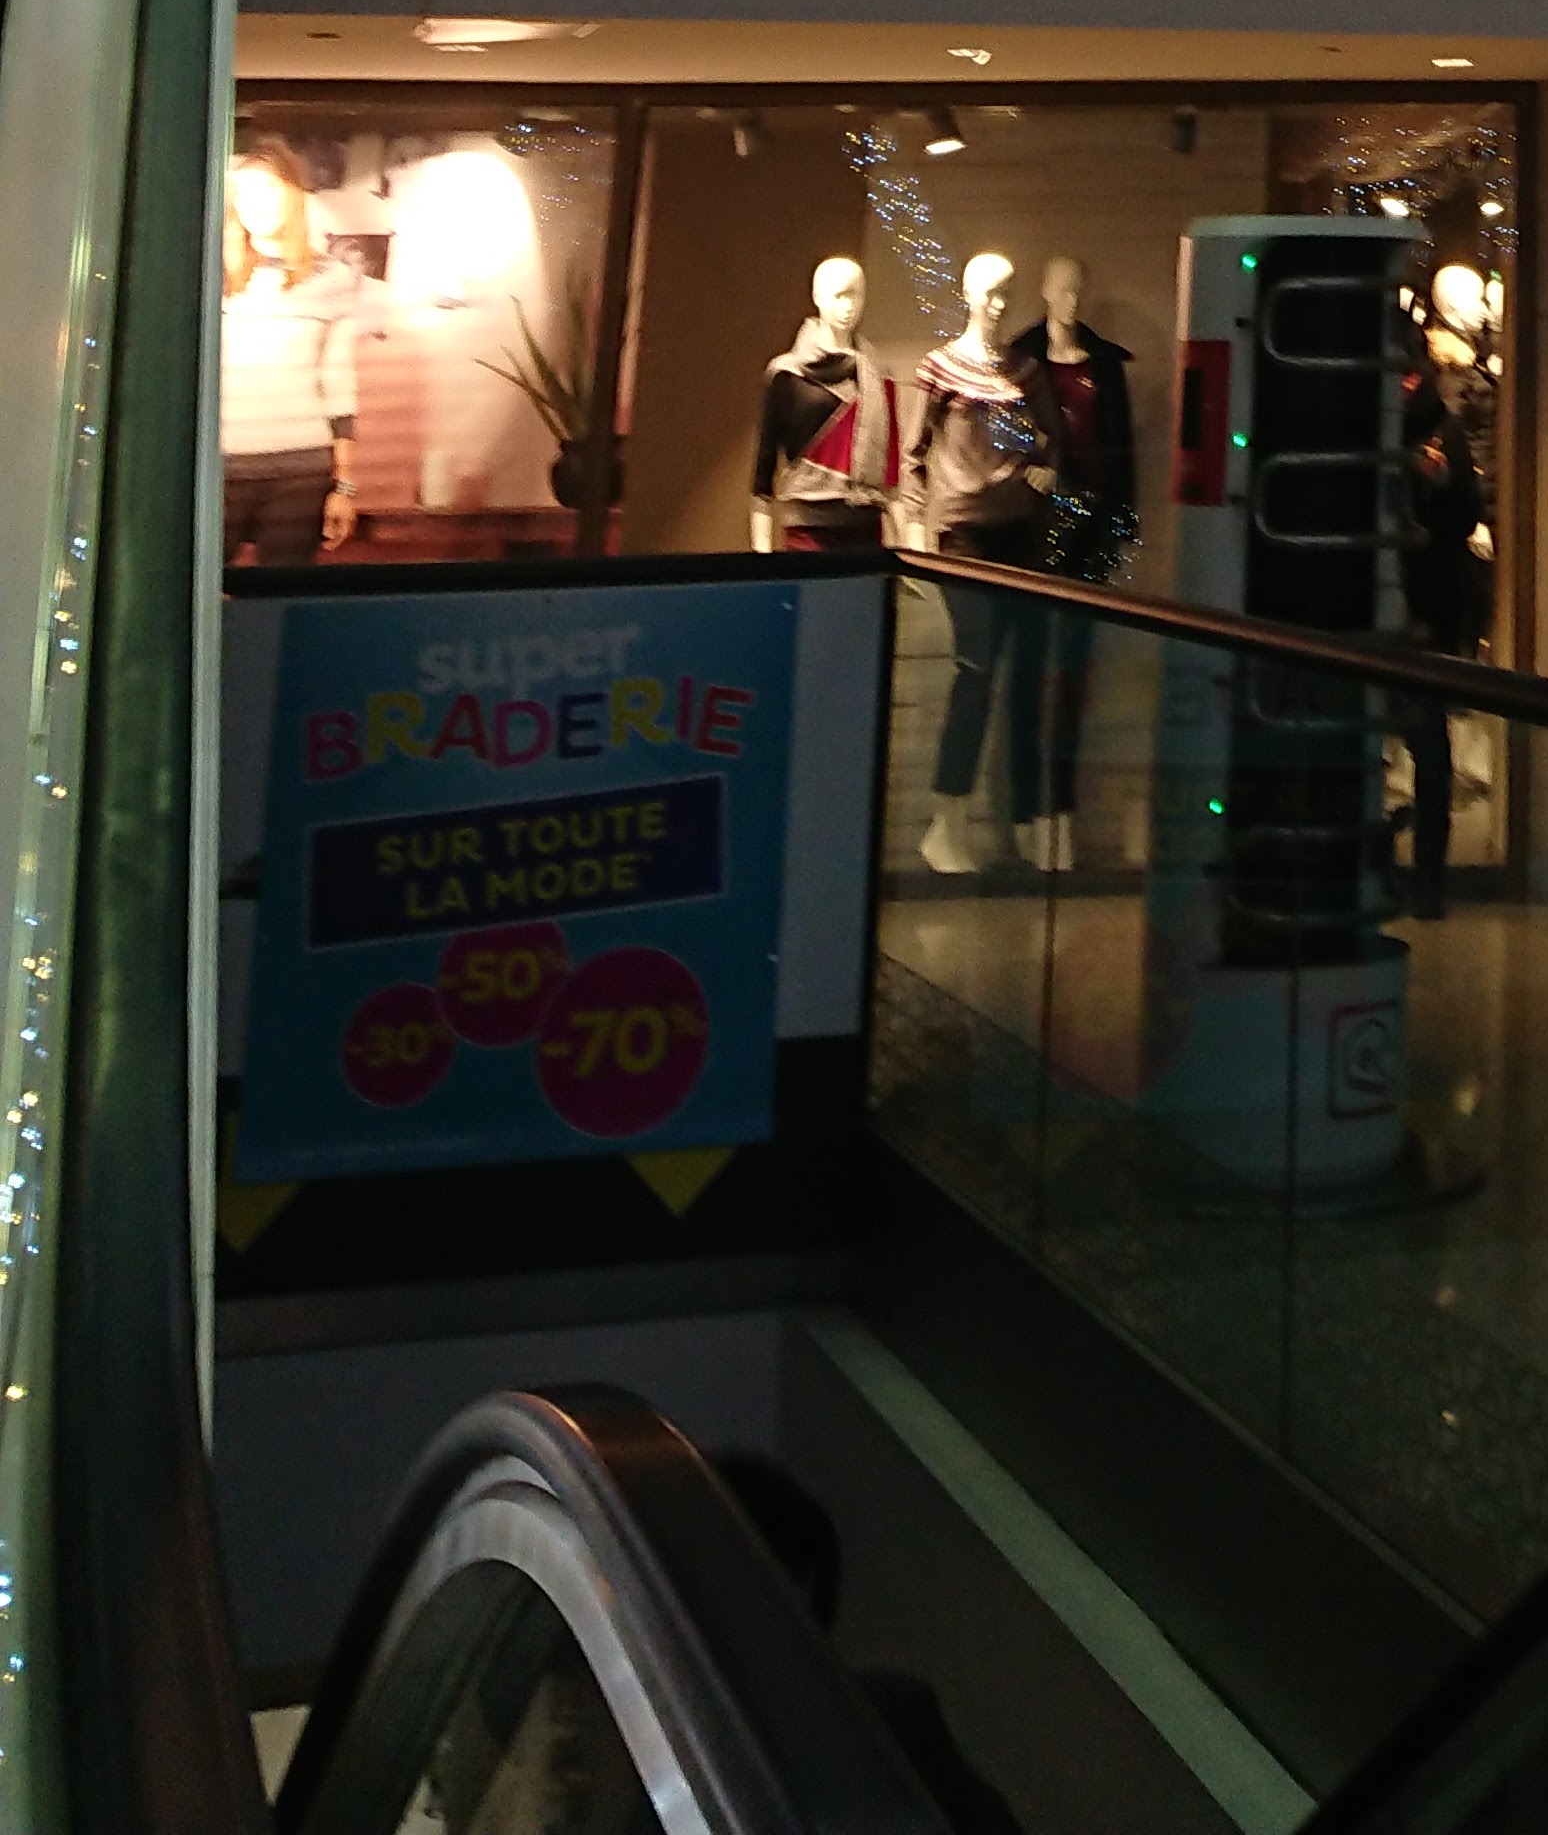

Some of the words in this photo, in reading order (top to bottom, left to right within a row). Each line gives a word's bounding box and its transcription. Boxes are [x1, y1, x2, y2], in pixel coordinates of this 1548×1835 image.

[419, 627, 640, 697] super
[306, 676, 752, 780] BRADERIE
[376, 826, 485, 875] SUR
[499, 803, 668, 857] TOUTE
[406, 877, 471, 919] LA
